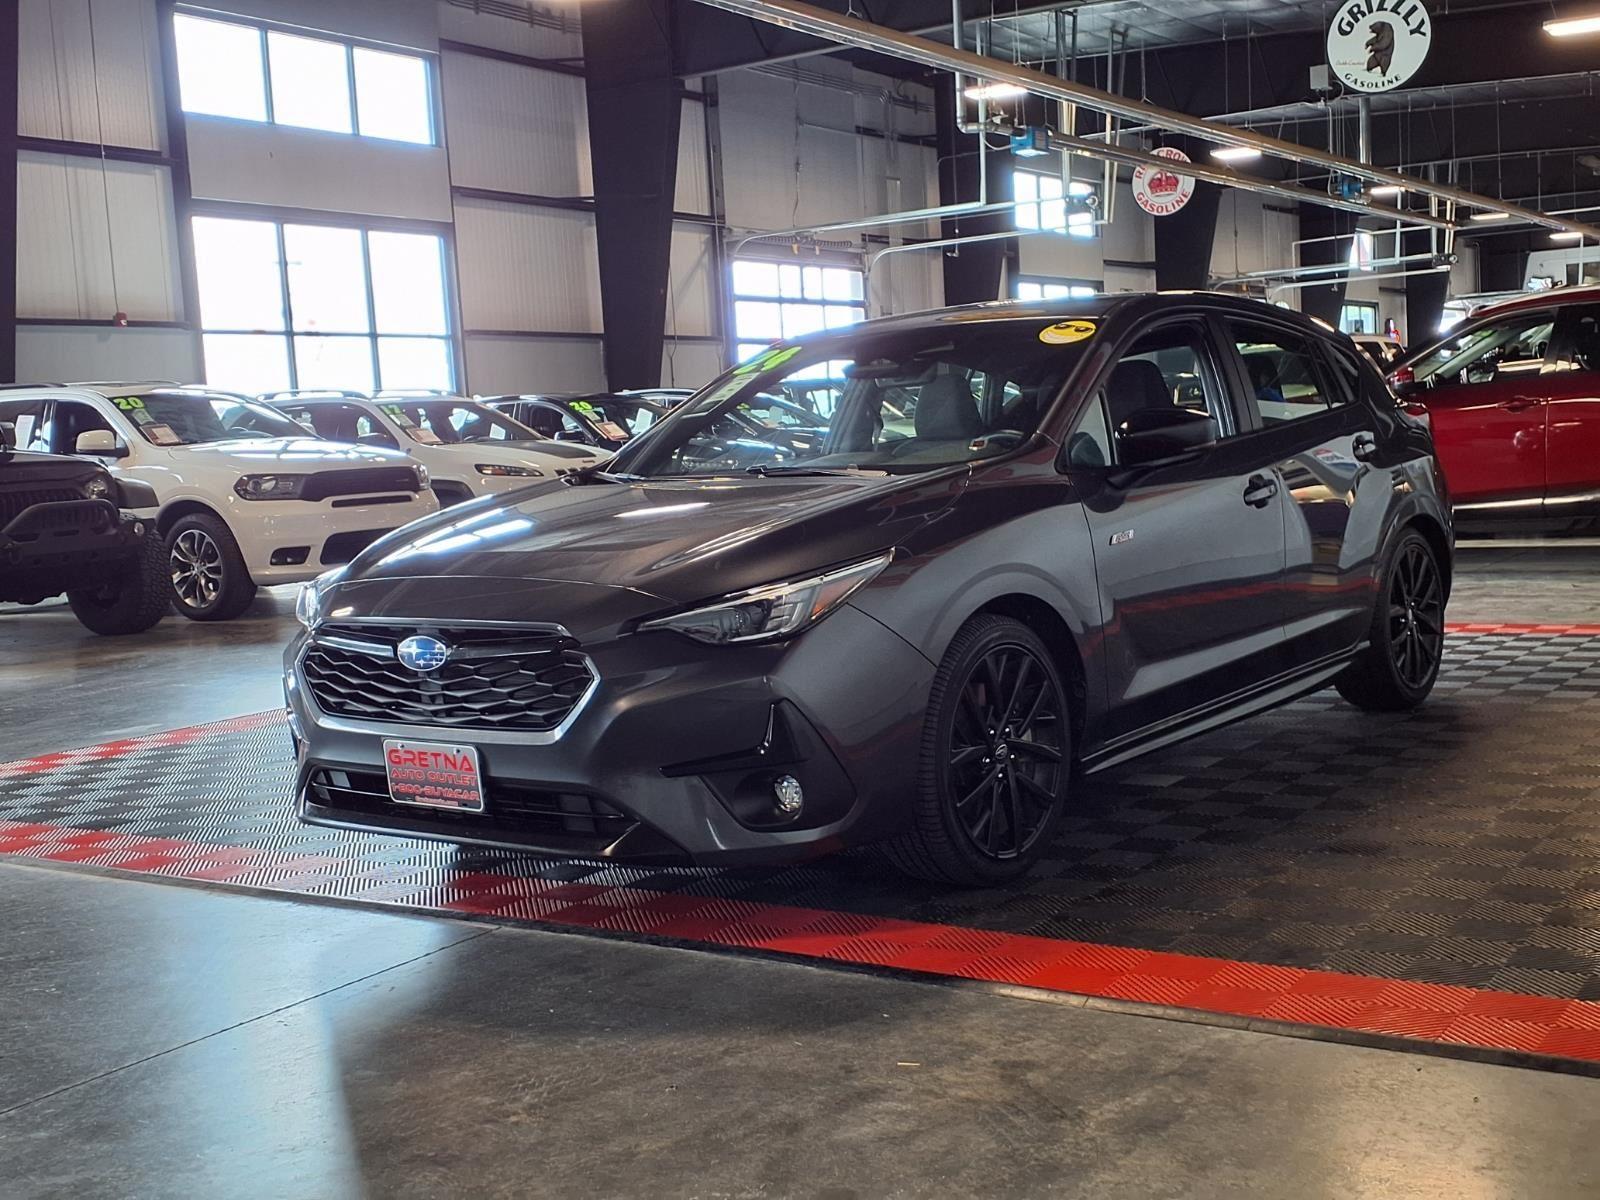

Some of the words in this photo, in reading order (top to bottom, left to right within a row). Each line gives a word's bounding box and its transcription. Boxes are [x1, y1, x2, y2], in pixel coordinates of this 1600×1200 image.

[1344, 73, 1402, 89] GASOLINE
[1136, 189, 1191, 214] GASOLINE
[113, 396, 144, 410] 20
[388, 748, 475, 773] GRETNA
[391, 768, 426, 781] AUTO
[427, 771, 478, 787] OUTLET
